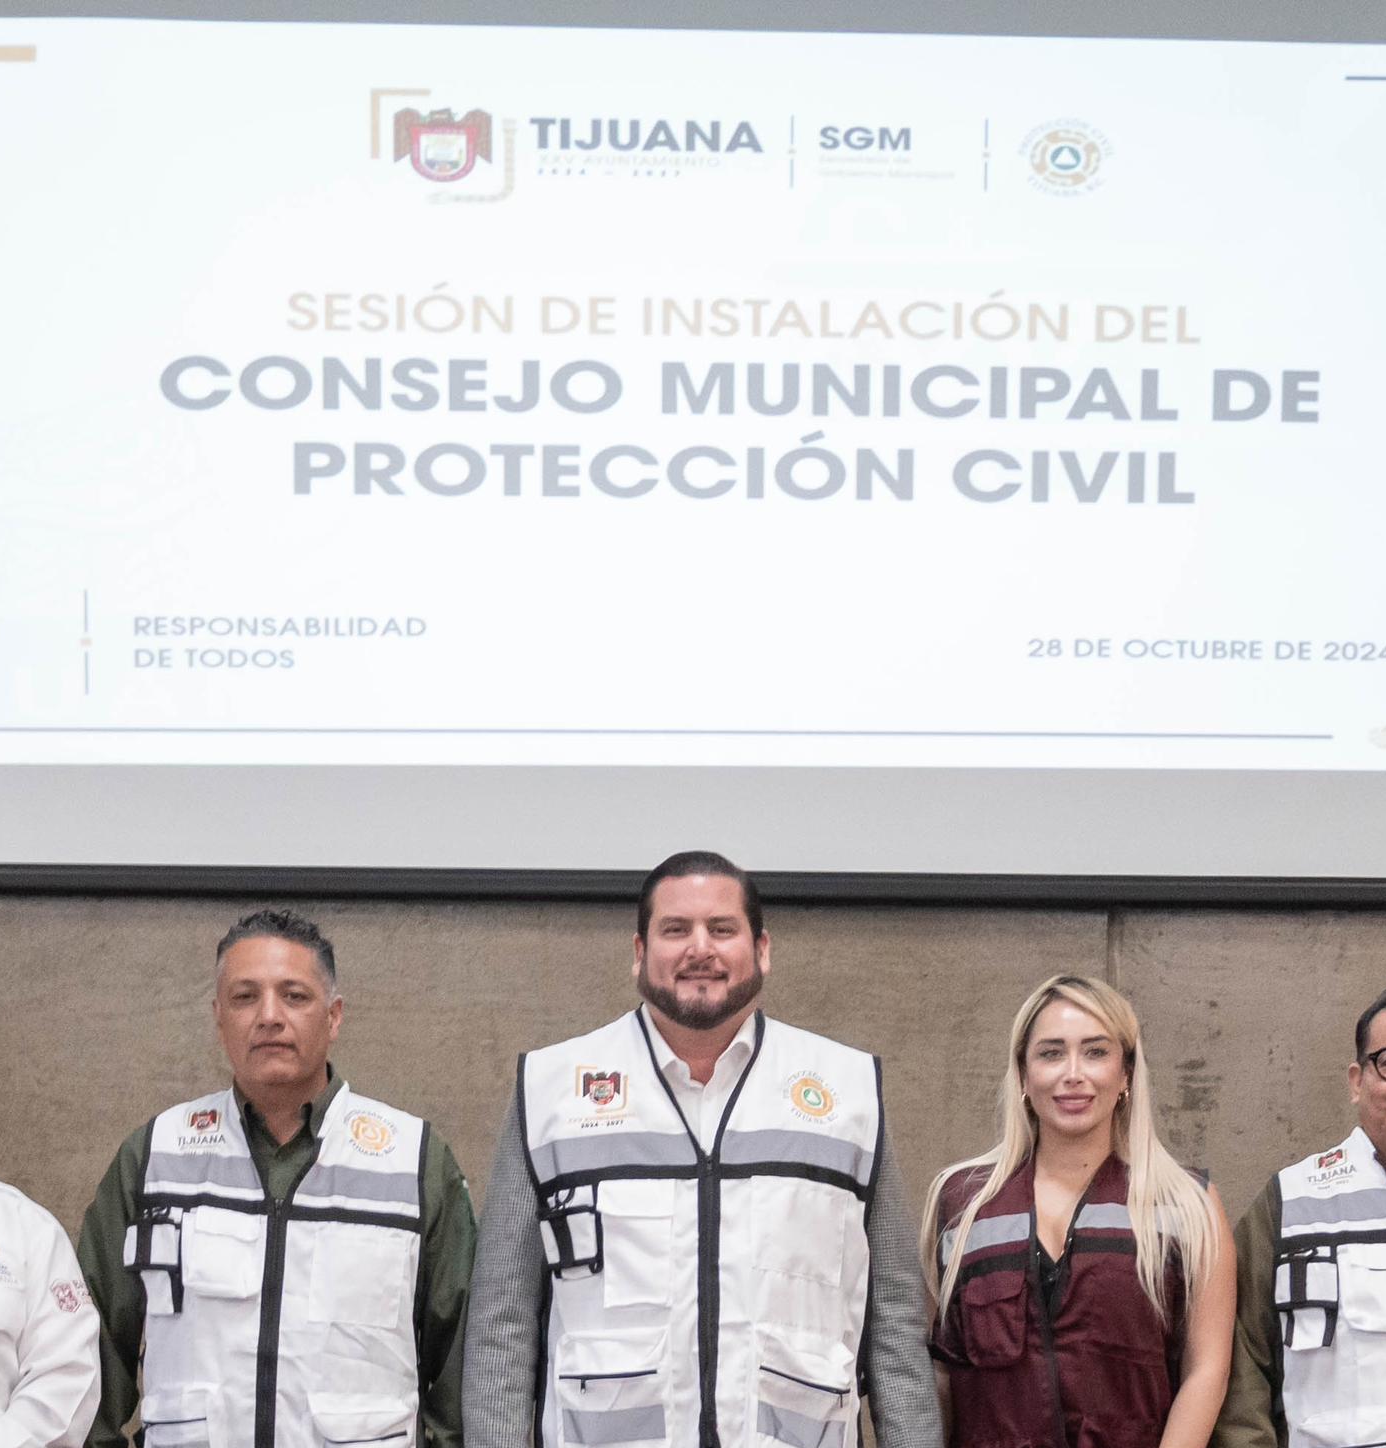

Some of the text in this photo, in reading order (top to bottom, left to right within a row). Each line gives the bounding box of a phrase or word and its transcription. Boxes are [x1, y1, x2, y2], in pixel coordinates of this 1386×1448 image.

[530, 117, 764, 153] TIJUANA
[819, 126, 912, 152] SGM
[287, 282, 1202, 346] SESIÓN DE INSTALACIÓN DEL
[160, 355, 1322, 425] CONSEJO MUNICIPAL DE
[293, 430, 1196, 506] PROTECCIÓN CIVIL
[133, 616, 428, 639] RESPONSABILIDAD
[134, 648, 297, 670] DE TODOS
[1029, 638, 1065, 660] 28
[1074, 638, 1112, 660] DE
[1123, 638, 1264, 662] OCTUBRE
[1274, 640, 1313, 663] DE
[178, 1134, 226, 1147] TIJUANA
[1307, 1164, 1357, 1183] TIJUANA
